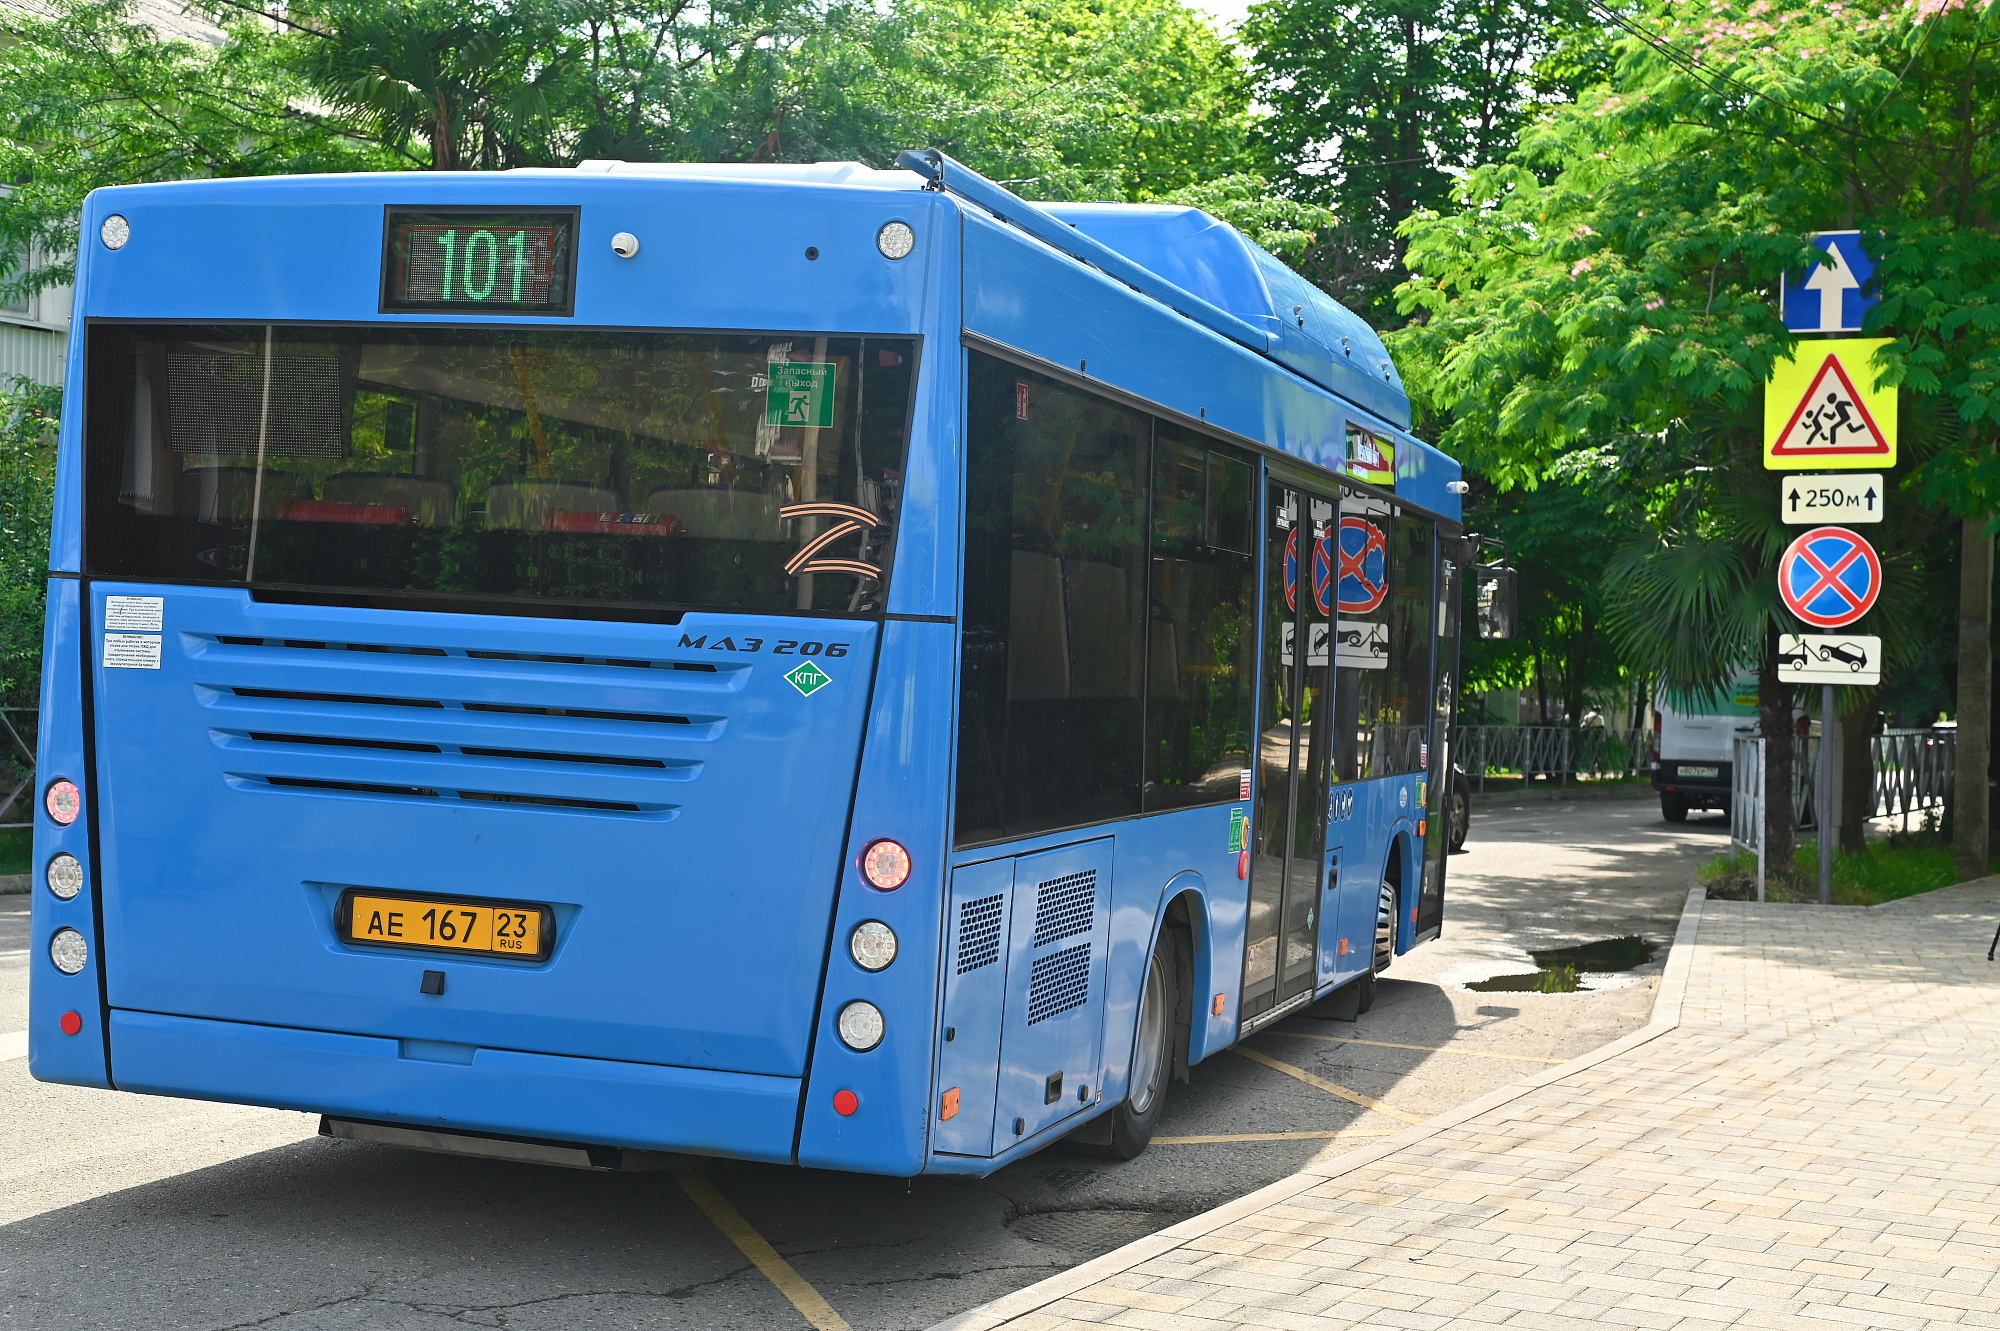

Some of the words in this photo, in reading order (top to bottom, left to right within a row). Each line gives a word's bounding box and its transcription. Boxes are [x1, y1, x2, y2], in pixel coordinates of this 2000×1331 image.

[437, 230, 525, 301] 101
[777, 366, 828, 376] Запасный
[785, 380, 818, 388] выход
[1805, 488, 1860, 507] 250м
[677, 634, 764, 652] МАЗ
[772, 640, 851, 657] 206
[794, 671, 822, 685] КПГ
[367, 910, 404, 937] AE
[421, 908, 477, 943] 167
[496, 913, 527, 938] 23
[500, 939, 523, 949] RUS
